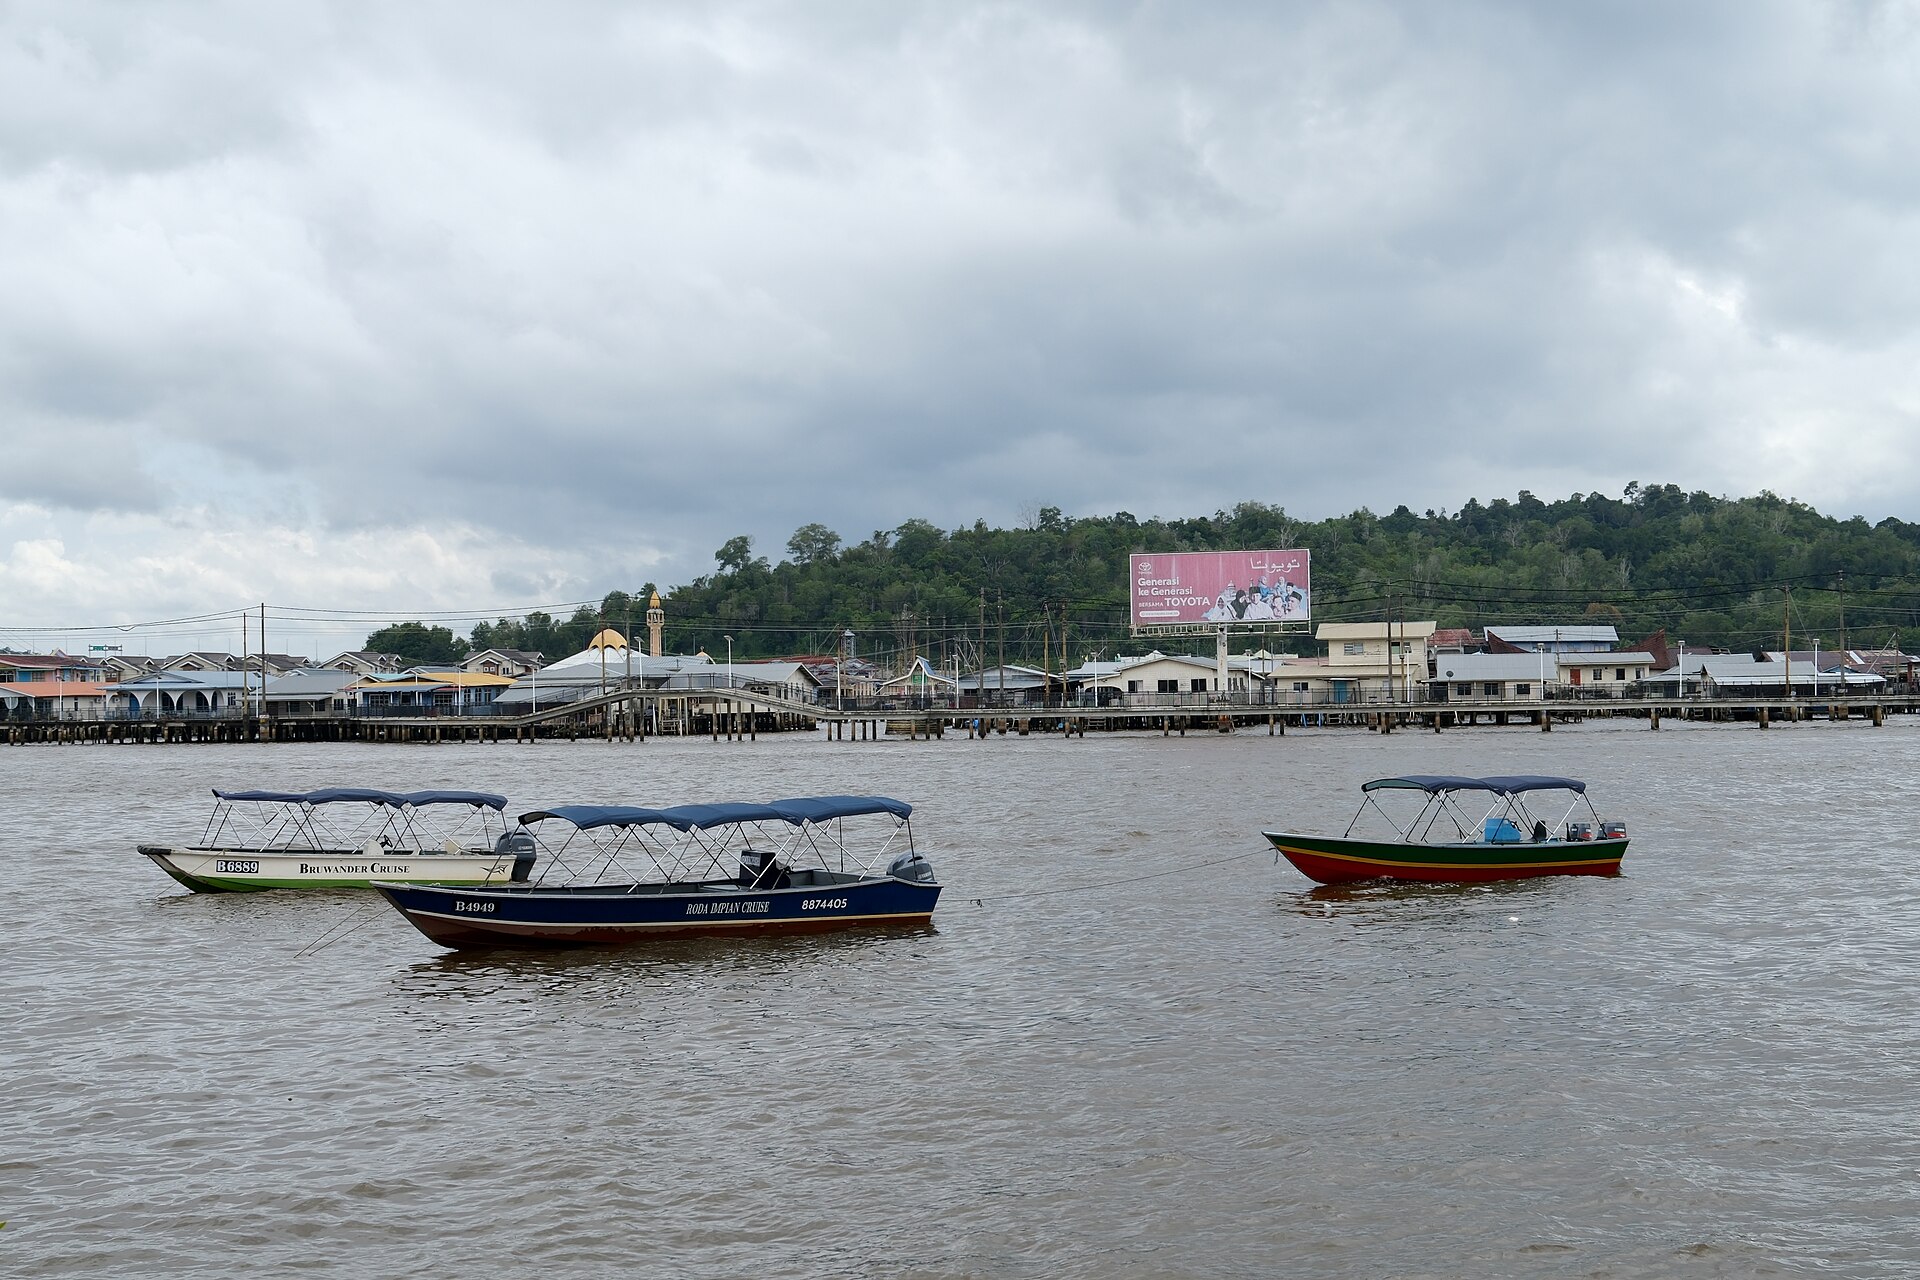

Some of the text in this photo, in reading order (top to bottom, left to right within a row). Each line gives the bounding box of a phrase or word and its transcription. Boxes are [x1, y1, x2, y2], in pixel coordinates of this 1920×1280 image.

[1138, 576, 1179, 587] Generasi
[1138, 586, 1192, 596] ke Generasi
[1164, 596, 1210, 607] TOYOTA
[370, 862, 410, 873] CRUISE
[455, 901, 495, 912] B4949
[686, 901, 770, 915] RODA IMPIAN CRUISE
[801, 898, 848, 910] 8874405
